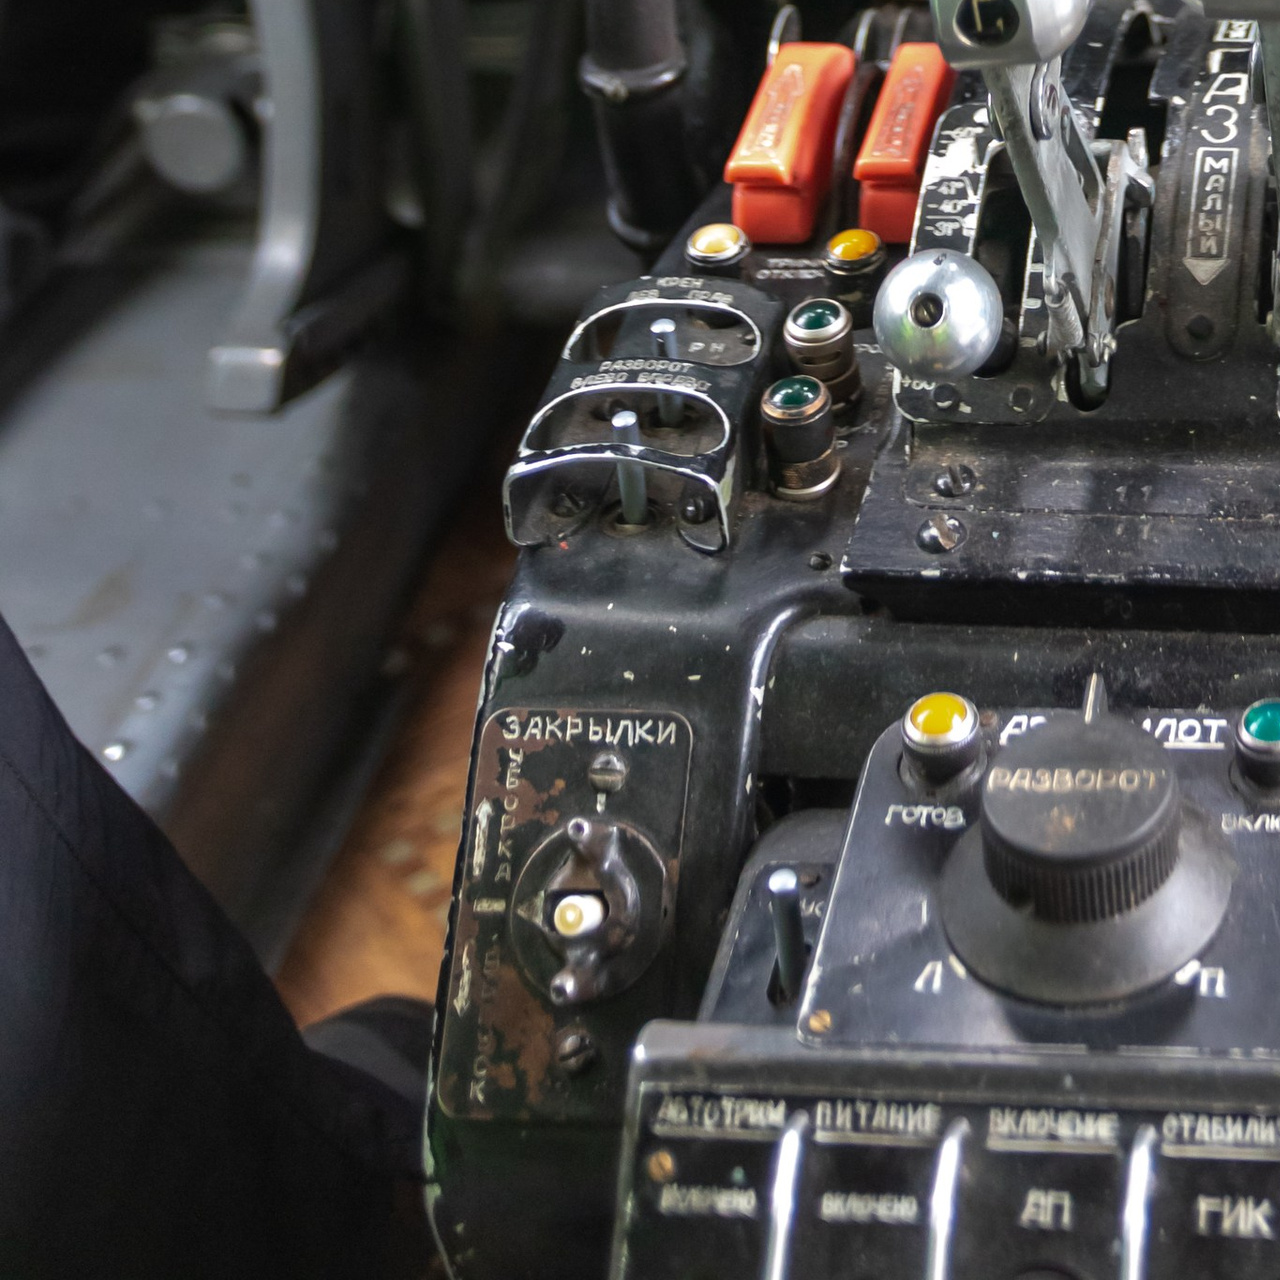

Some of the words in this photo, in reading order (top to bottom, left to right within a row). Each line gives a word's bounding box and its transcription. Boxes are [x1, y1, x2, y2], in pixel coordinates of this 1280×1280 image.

[599, 360, 696, 373] РАЗВОРОТ
[502, 715, 678, 747] ЗАКРЫЛКИ
[986, 767, 1166, 793] РАЗВОРОТ
[885, 803, 967, 829] ГОТОВ
[815, 1099, 942, 1135] ПИТАНИЕ
[989, 1107, 1120, 1140] ВКЛЮЧЕНИЕ
[1196, 1194, 1275, 1240] ГИК
